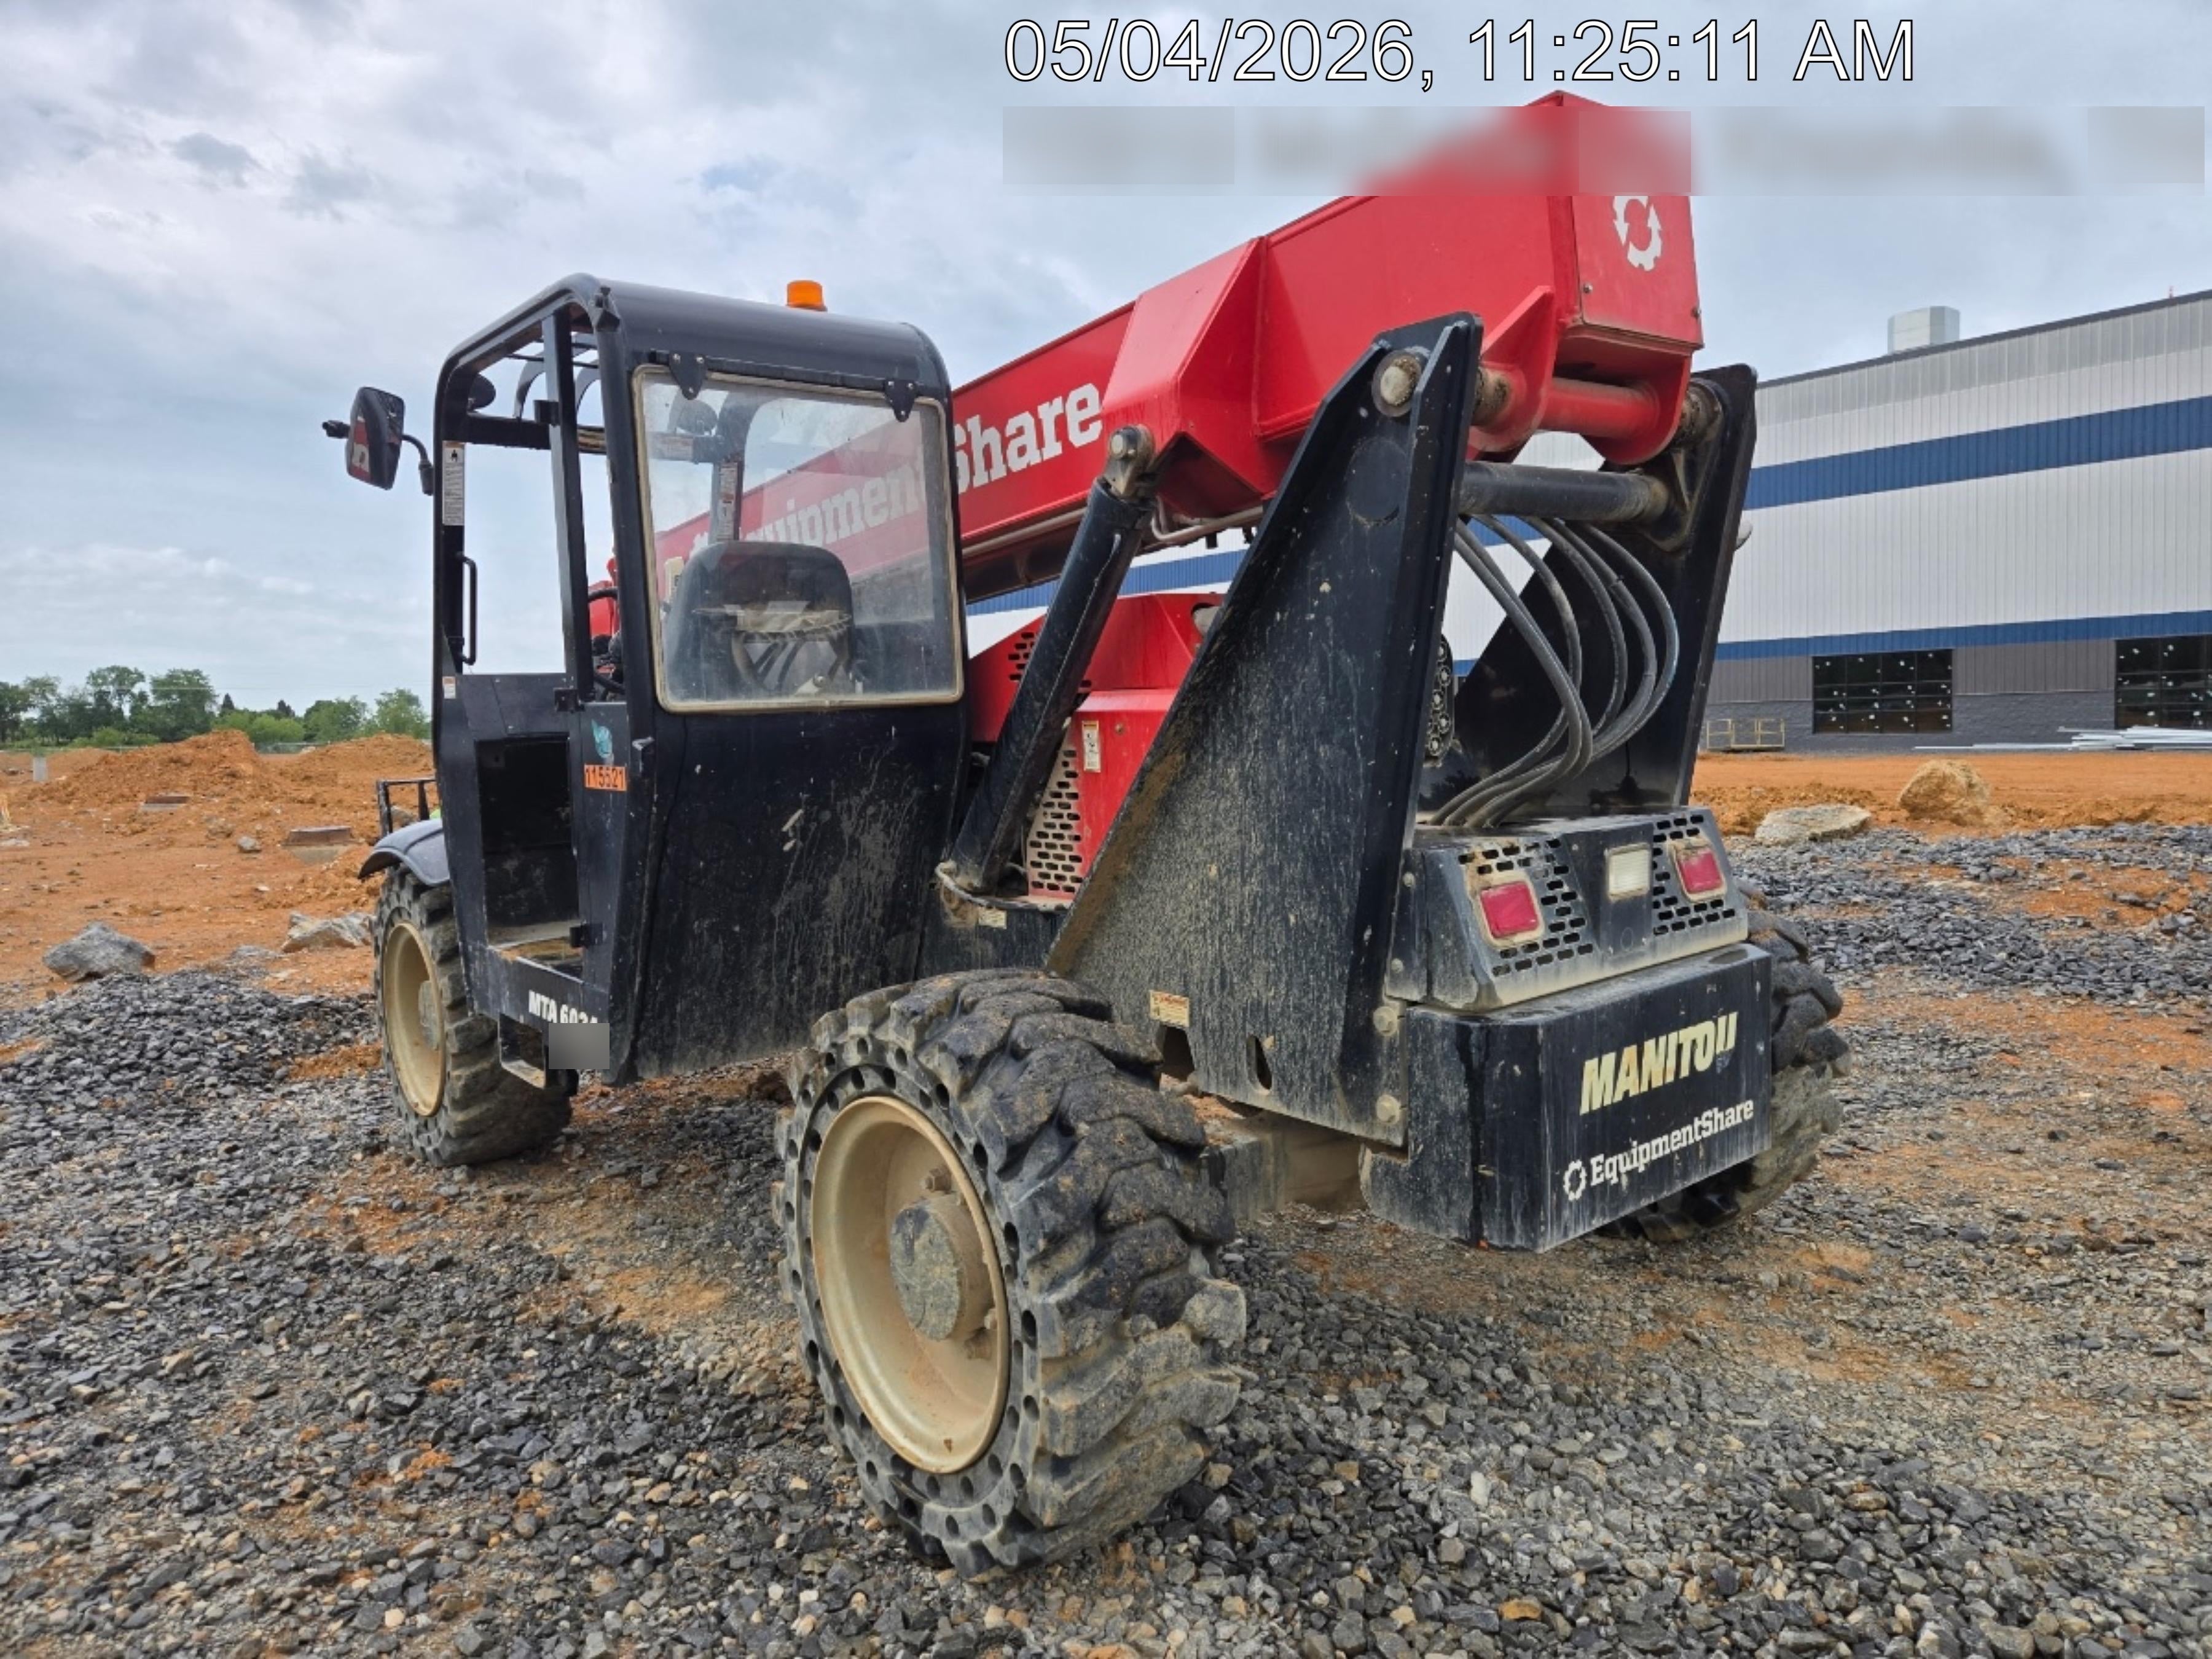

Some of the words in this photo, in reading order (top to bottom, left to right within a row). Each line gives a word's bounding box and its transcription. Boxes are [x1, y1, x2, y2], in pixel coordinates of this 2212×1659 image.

[739, 382, 1103, 546] uipmenShare
[528, 989, 557, 1024] MTA
[1579, 1011, 1739, 1116] MANITOU
[1590, 1099, 1754, 1186] EquipmentShare
